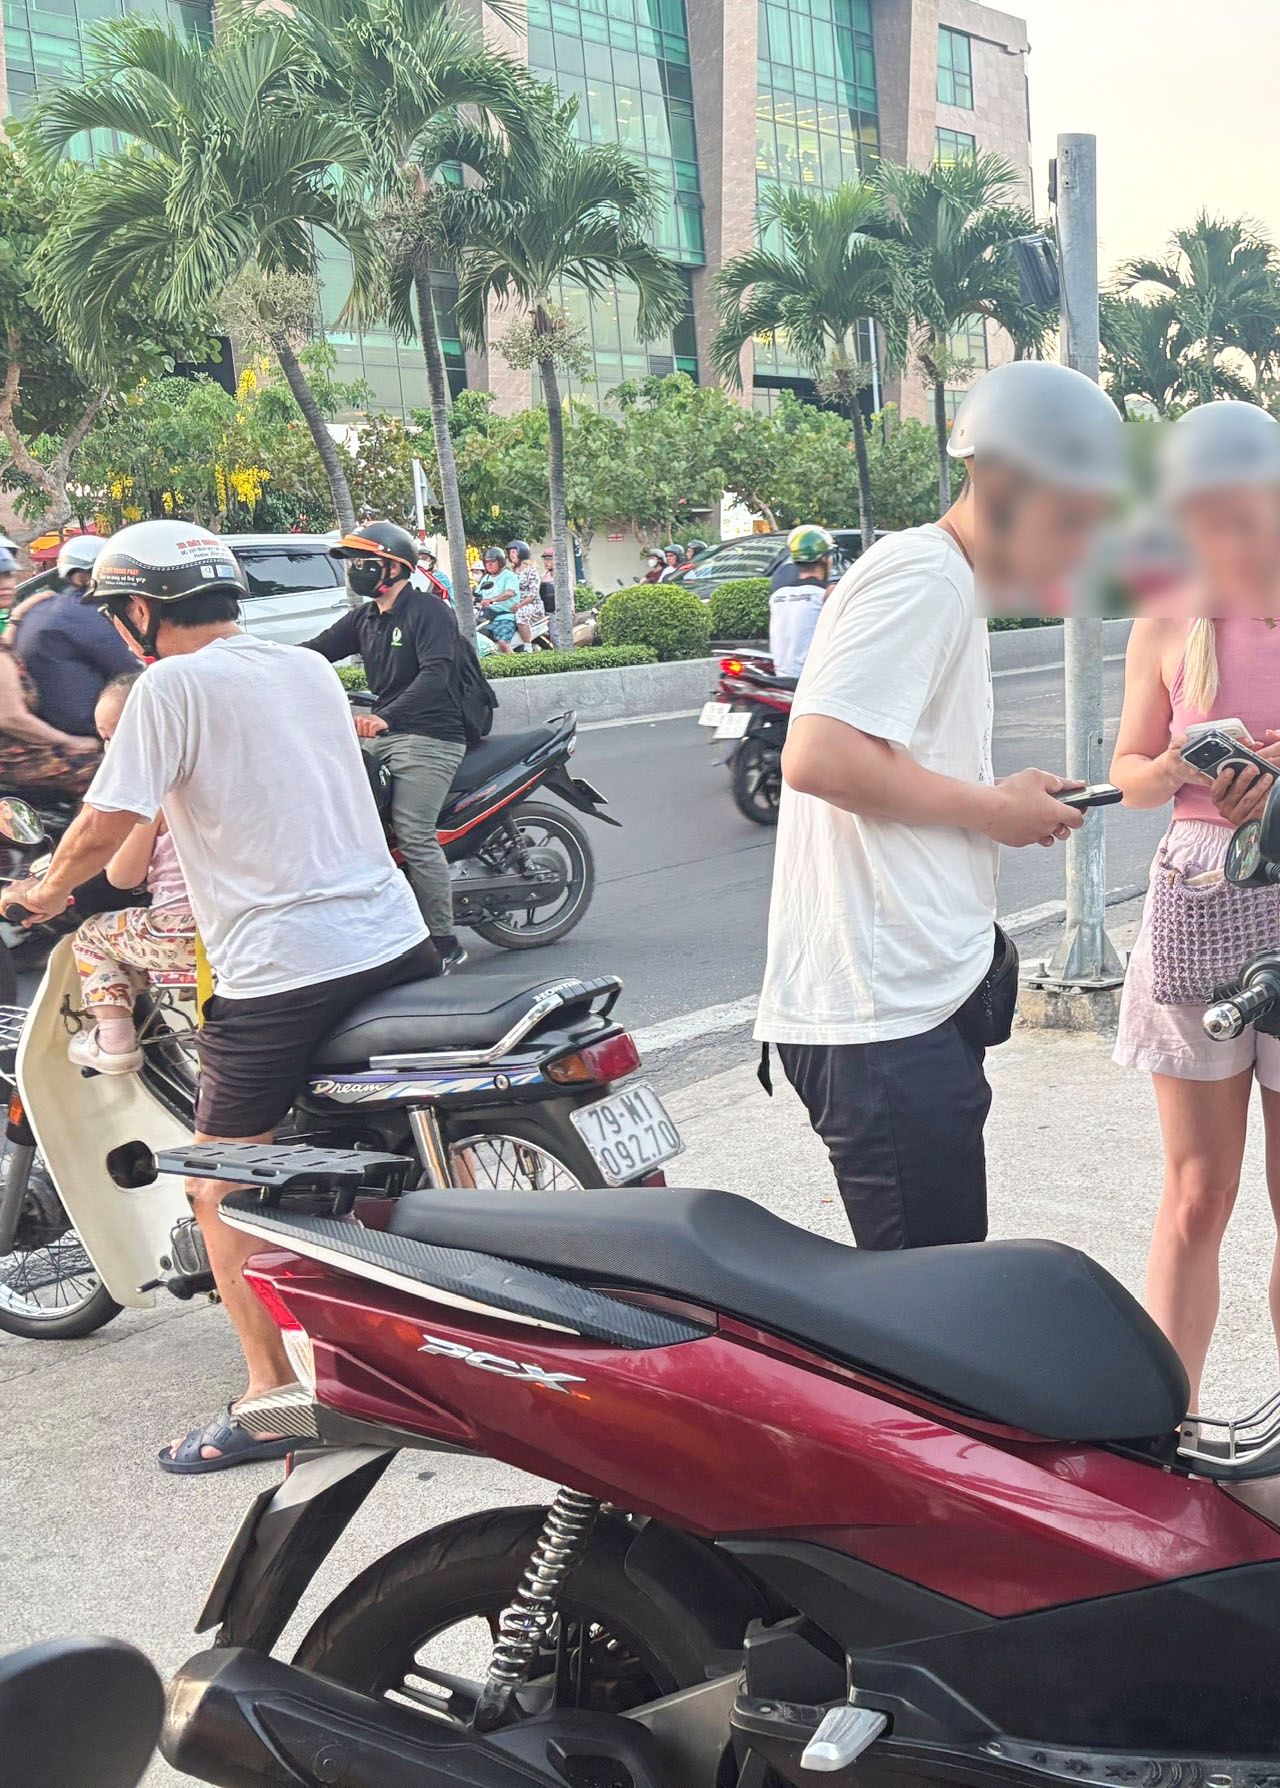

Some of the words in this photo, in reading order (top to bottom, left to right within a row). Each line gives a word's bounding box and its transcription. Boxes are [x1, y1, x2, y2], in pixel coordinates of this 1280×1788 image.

[308, 1080, 389, 1095] Dream
[588, 1091, 653, 1141] 79-N1
[600, 1120, 678, 1176] 092.70
[417, 1334, 587, 1394] PCX
